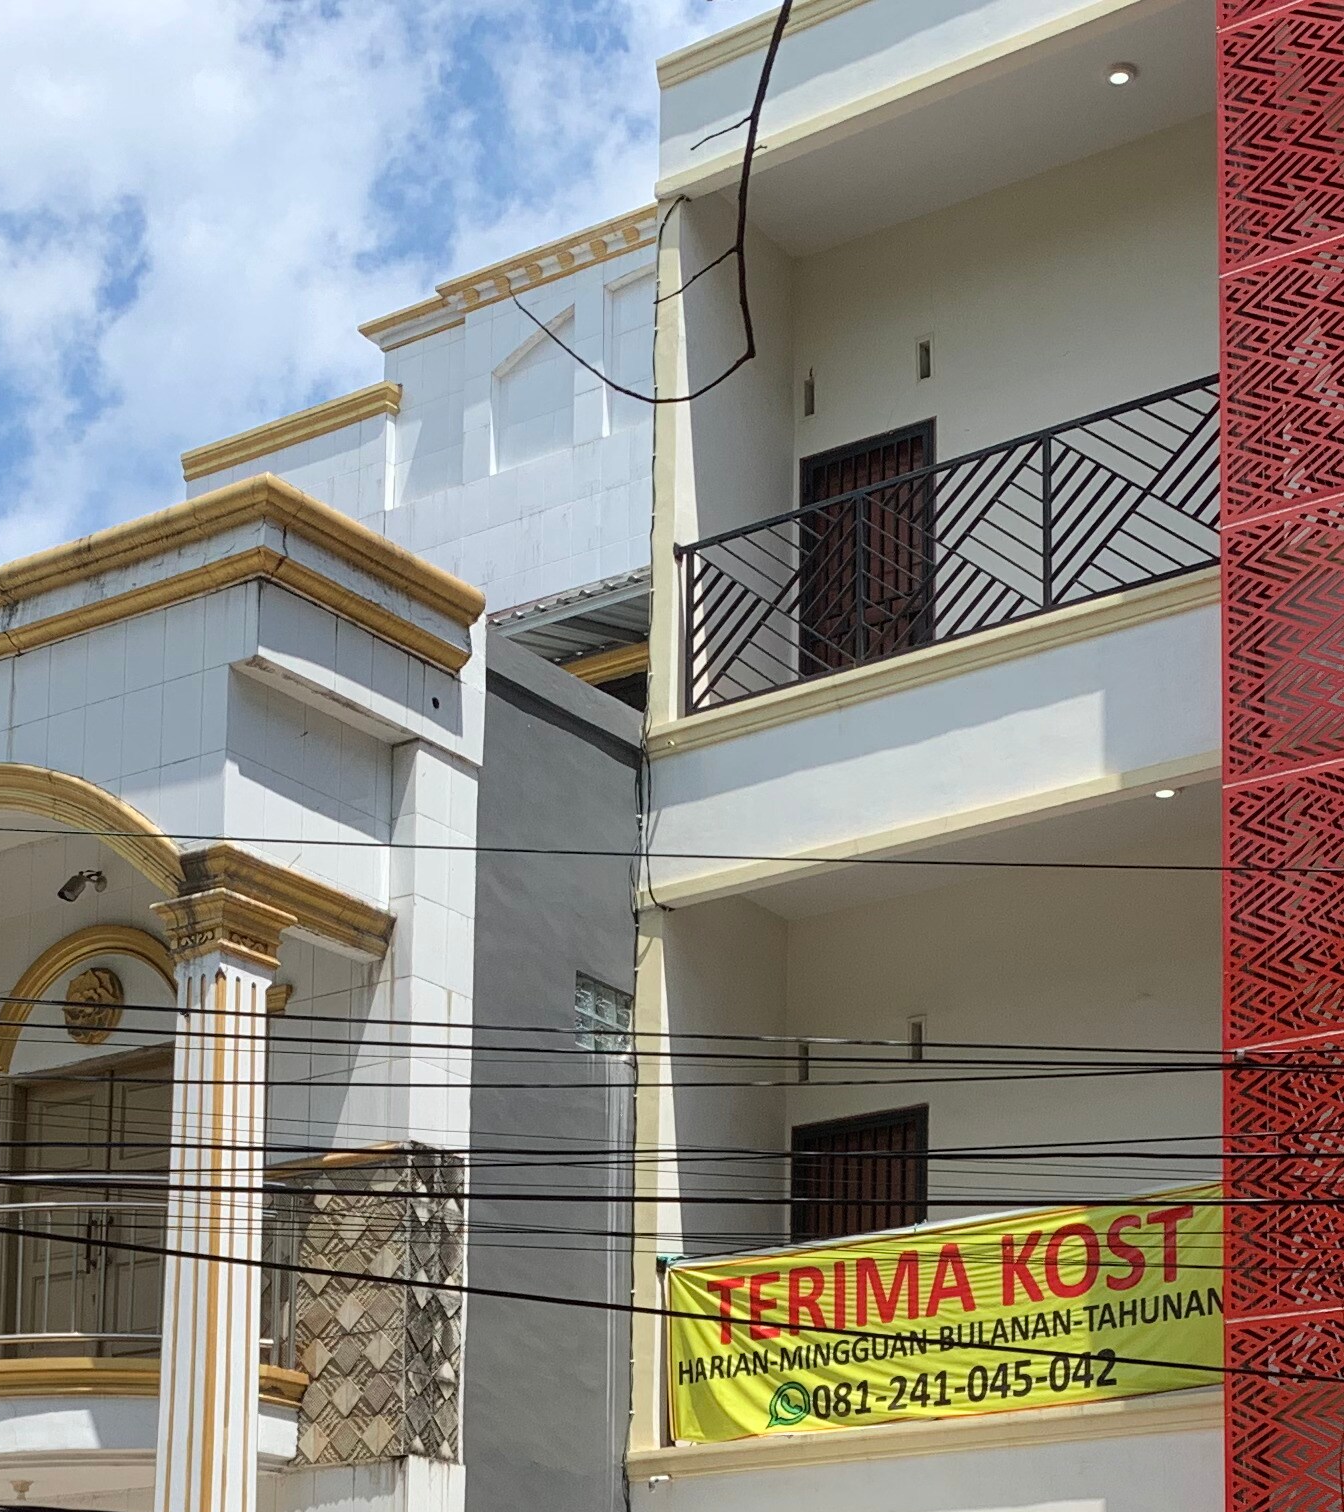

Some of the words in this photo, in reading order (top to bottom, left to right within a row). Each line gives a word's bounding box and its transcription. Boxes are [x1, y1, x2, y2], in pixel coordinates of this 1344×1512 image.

[707, 1243, 977, 1345] TERIMA
[1000, 1204, 1194, 1306] KOST
[812, 1348, 1118, 1420] 081-241-045-042
